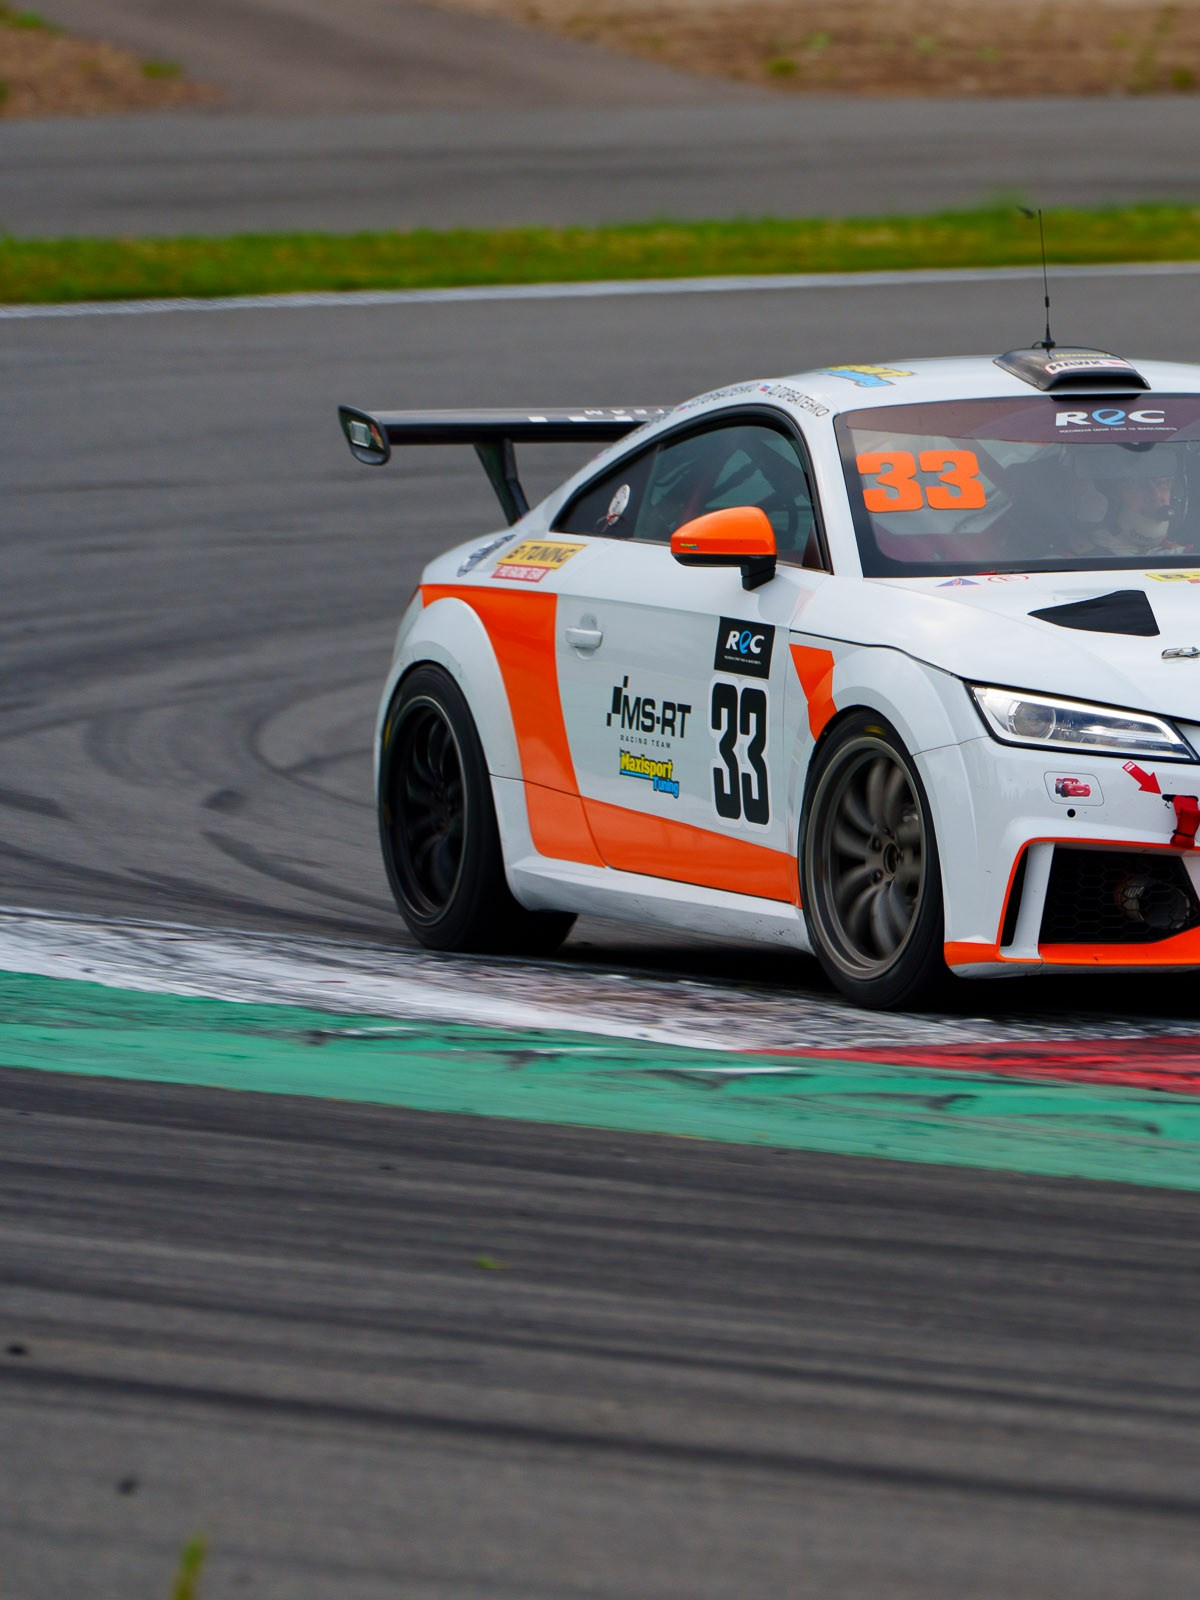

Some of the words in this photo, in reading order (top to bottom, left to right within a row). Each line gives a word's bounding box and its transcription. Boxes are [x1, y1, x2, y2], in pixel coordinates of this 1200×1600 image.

[855, 450, 987, 513] 33
[620, 734, 648, 746] RACING
[651, 739, 671, 748] TEAM
[711, 682, 770, 825] 33
[620, 749, 673, 779] Maxisport
[653, 775, 680, 799] Tuning
